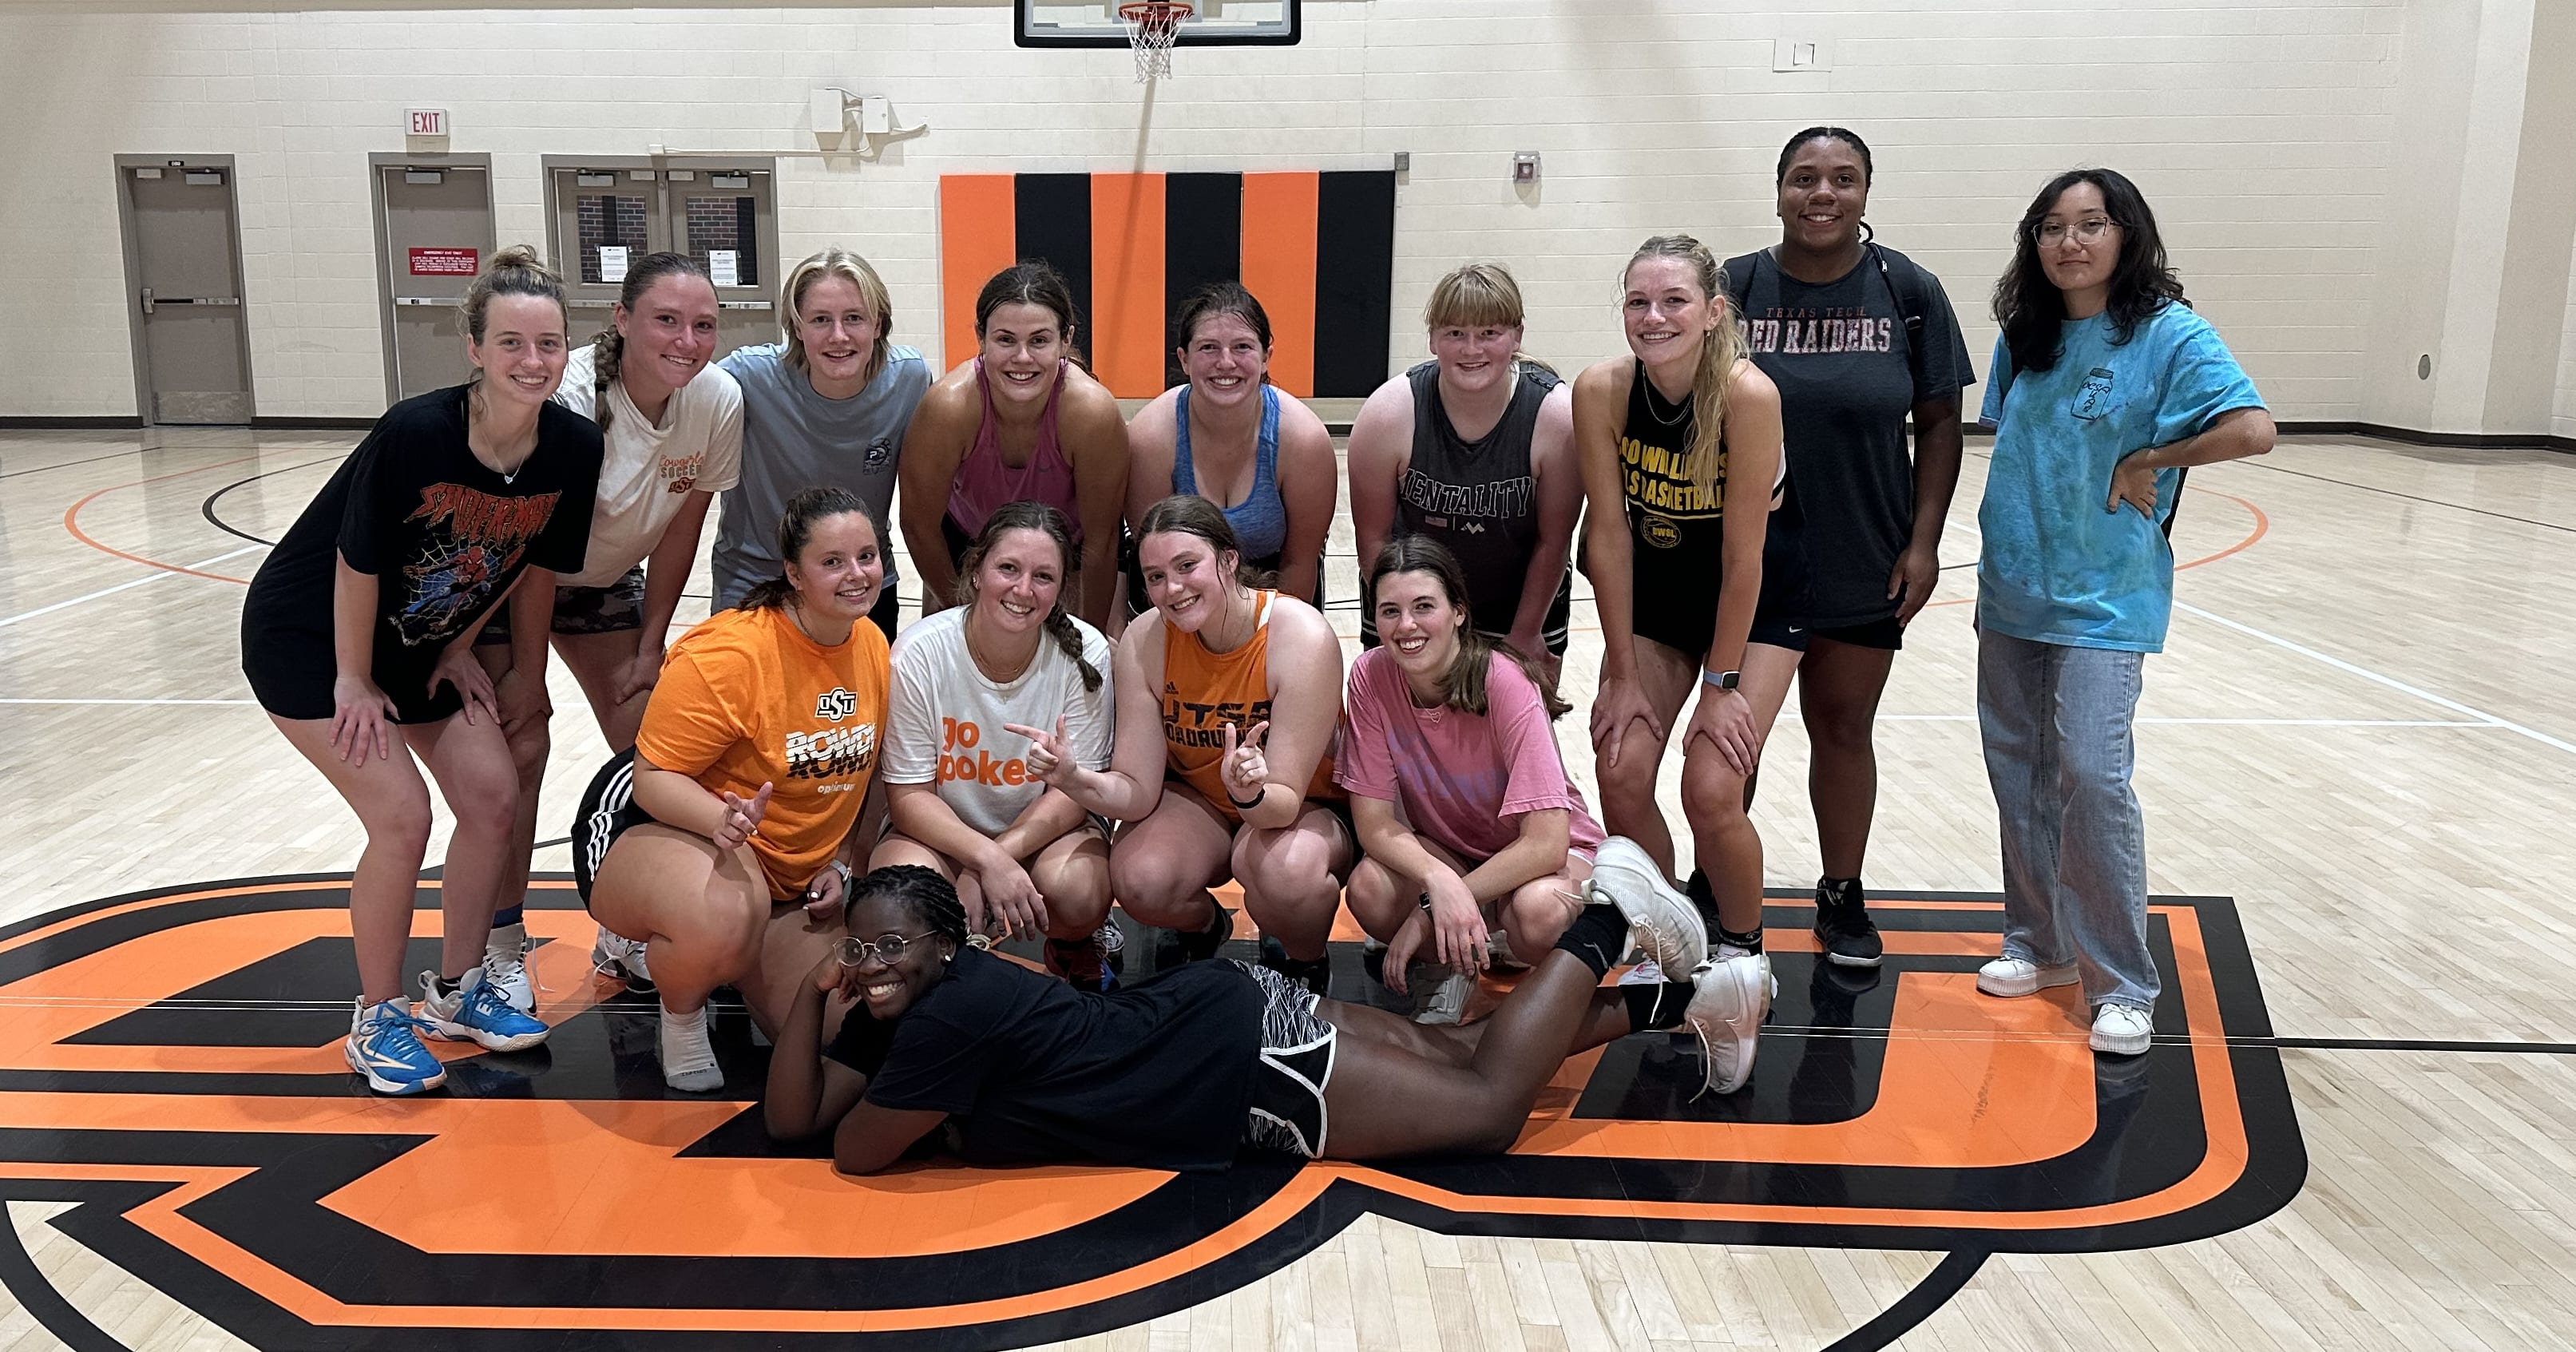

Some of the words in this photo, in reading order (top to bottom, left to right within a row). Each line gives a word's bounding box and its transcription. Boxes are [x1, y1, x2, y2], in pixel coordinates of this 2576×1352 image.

[412, 112, 440, 133] EXIT
[1766, 307, 1817, 319] TEXAS
[1782, 317, 1892, 355] RAIDERS
[815, 687, 858, 723] OSU
[942, 717, 980, 751] go
[937, 751, 1041, 787] poke
